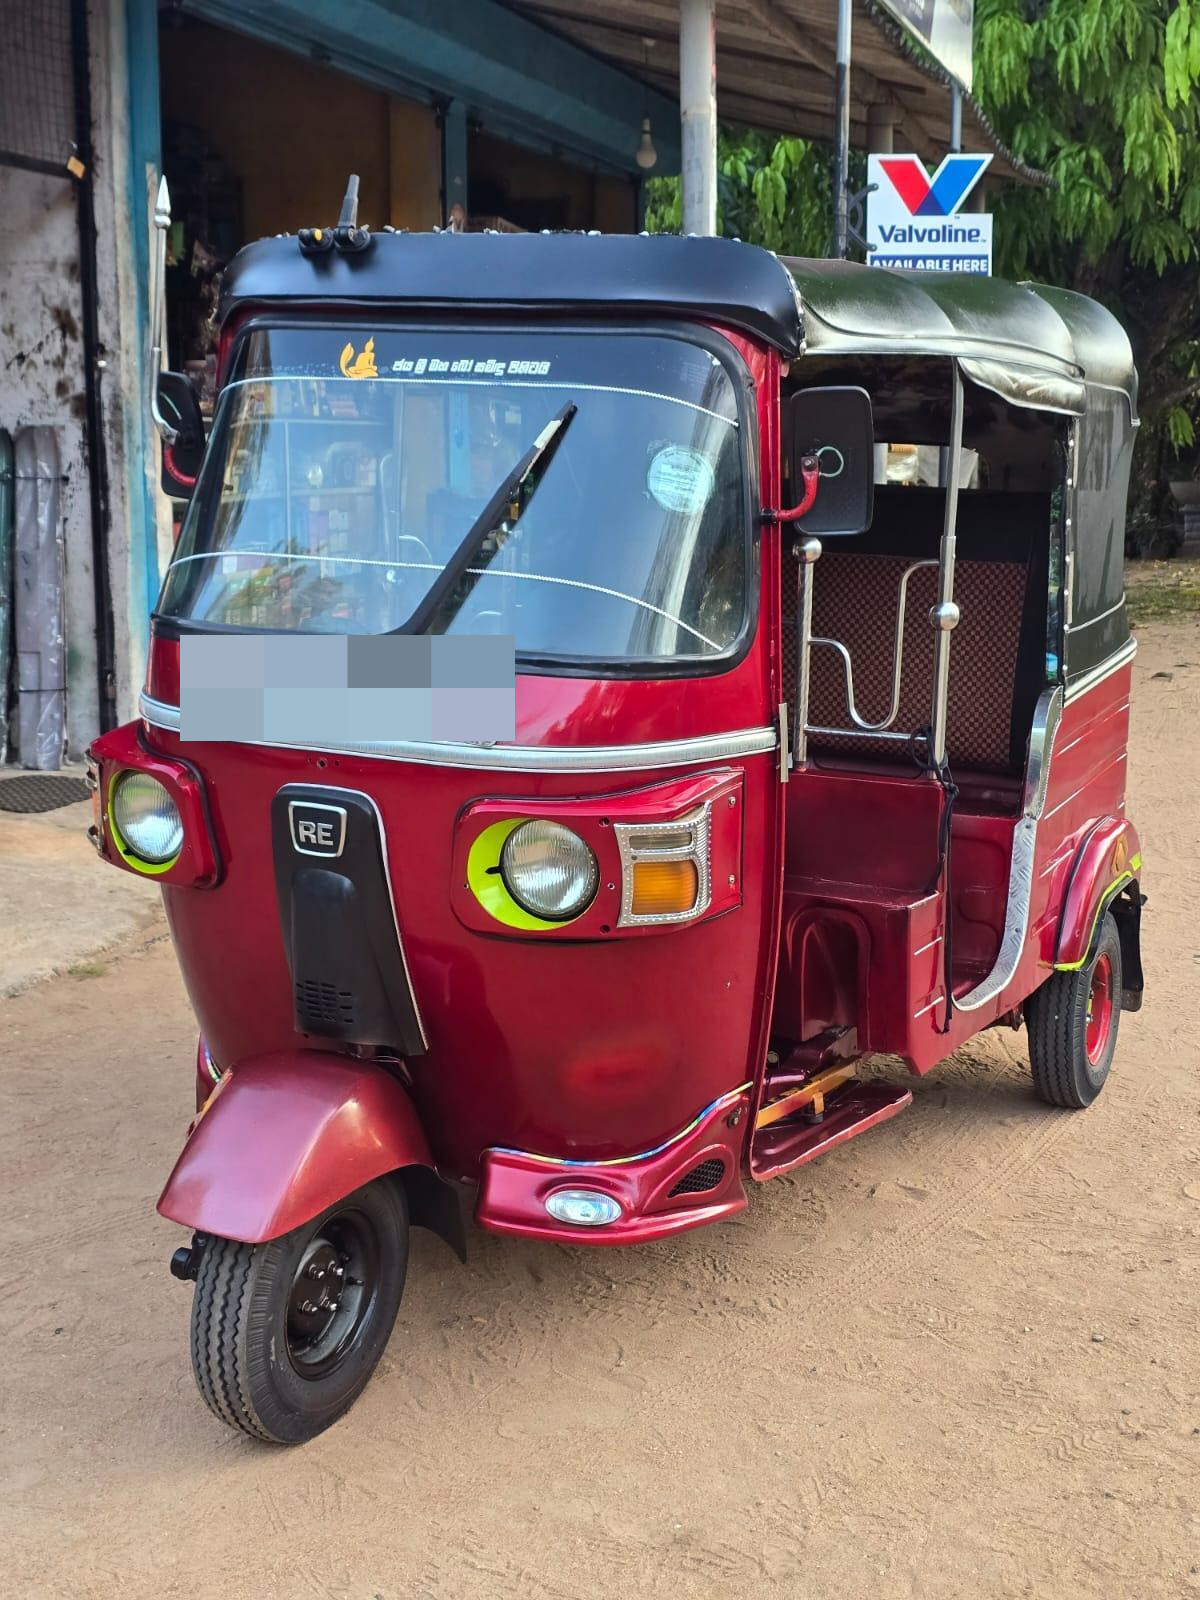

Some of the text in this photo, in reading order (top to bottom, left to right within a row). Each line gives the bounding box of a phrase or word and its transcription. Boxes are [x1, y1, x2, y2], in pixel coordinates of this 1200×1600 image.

[878, 224, 981, 243] Valvoline
[953, 259, 988, 273] HERE
[298, 821, 334, 846] RE
